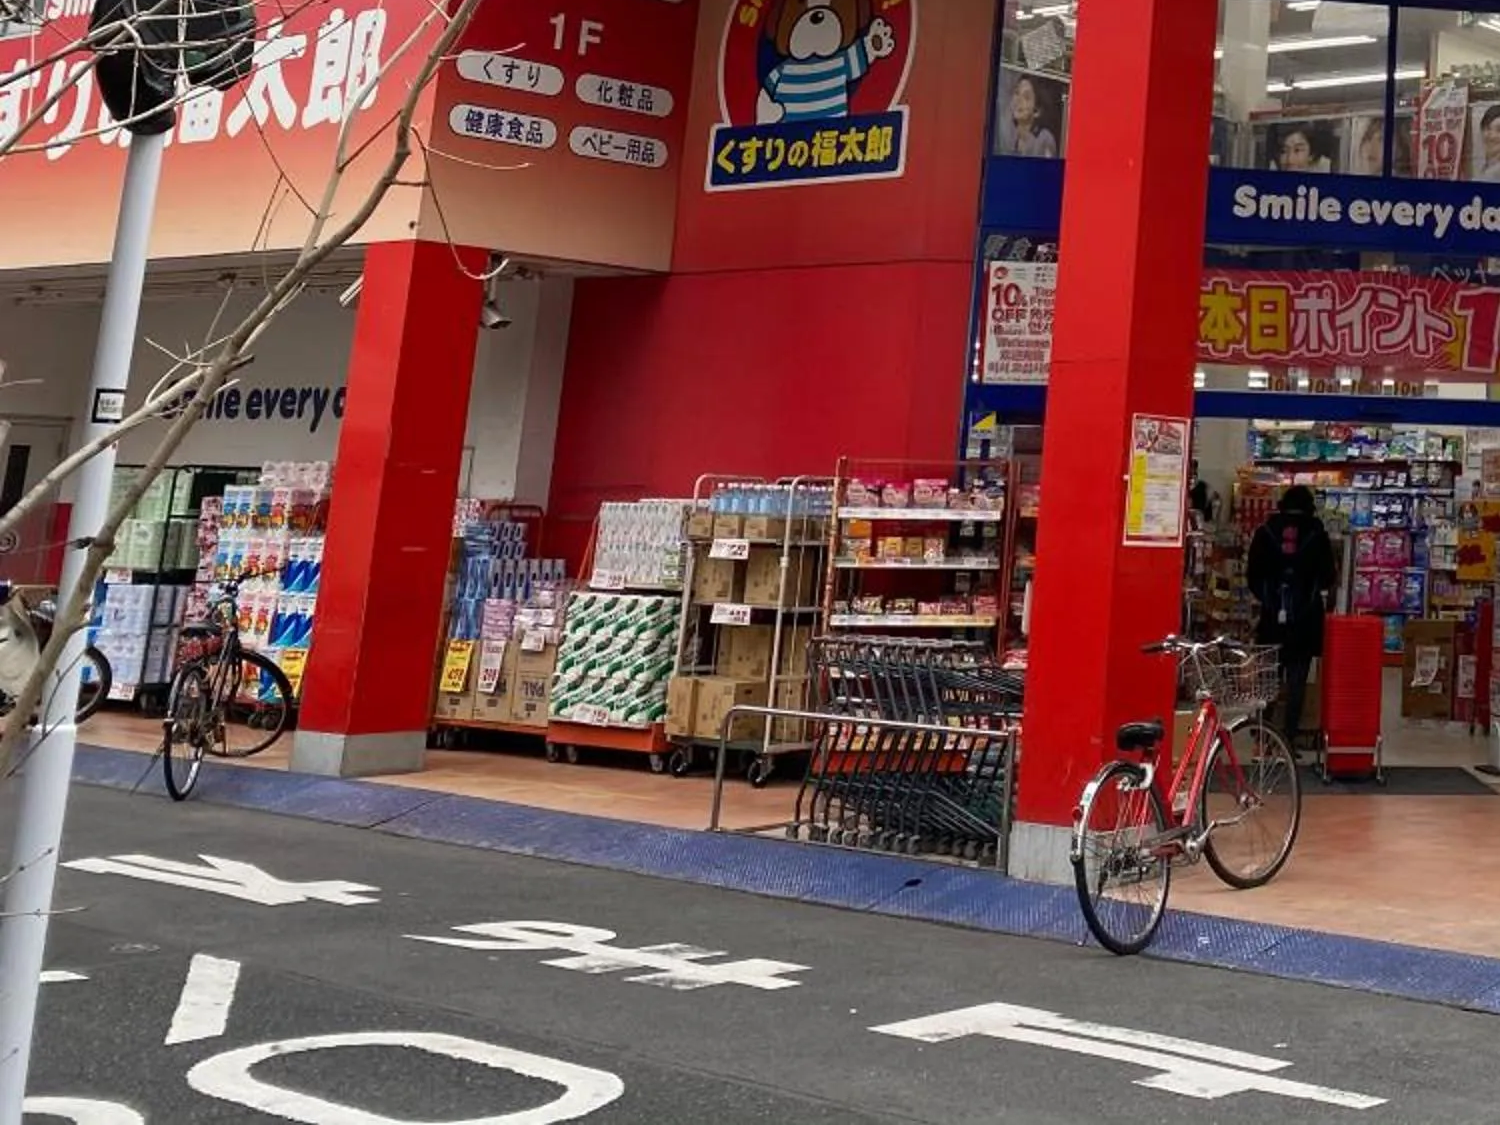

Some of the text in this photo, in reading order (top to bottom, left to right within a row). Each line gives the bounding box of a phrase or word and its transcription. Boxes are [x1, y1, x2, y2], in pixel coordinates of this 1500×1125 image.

[550, 13, 604, 56] 1F
[483, 57, 541, 89] くすり
[597, 80, 654, 112] 化粧品
[465, 108, 545, 145] 健康食品
[582, 132, 655, 165] ベビー用品
[716, 126, 893, 174] くすりの福太郎
[1232, 184, 1342, 222] Smile
[1349, 196, 1454, 239] every
[991, 308, 1027, 322] OFF
[246, 385, 330, 433] every
